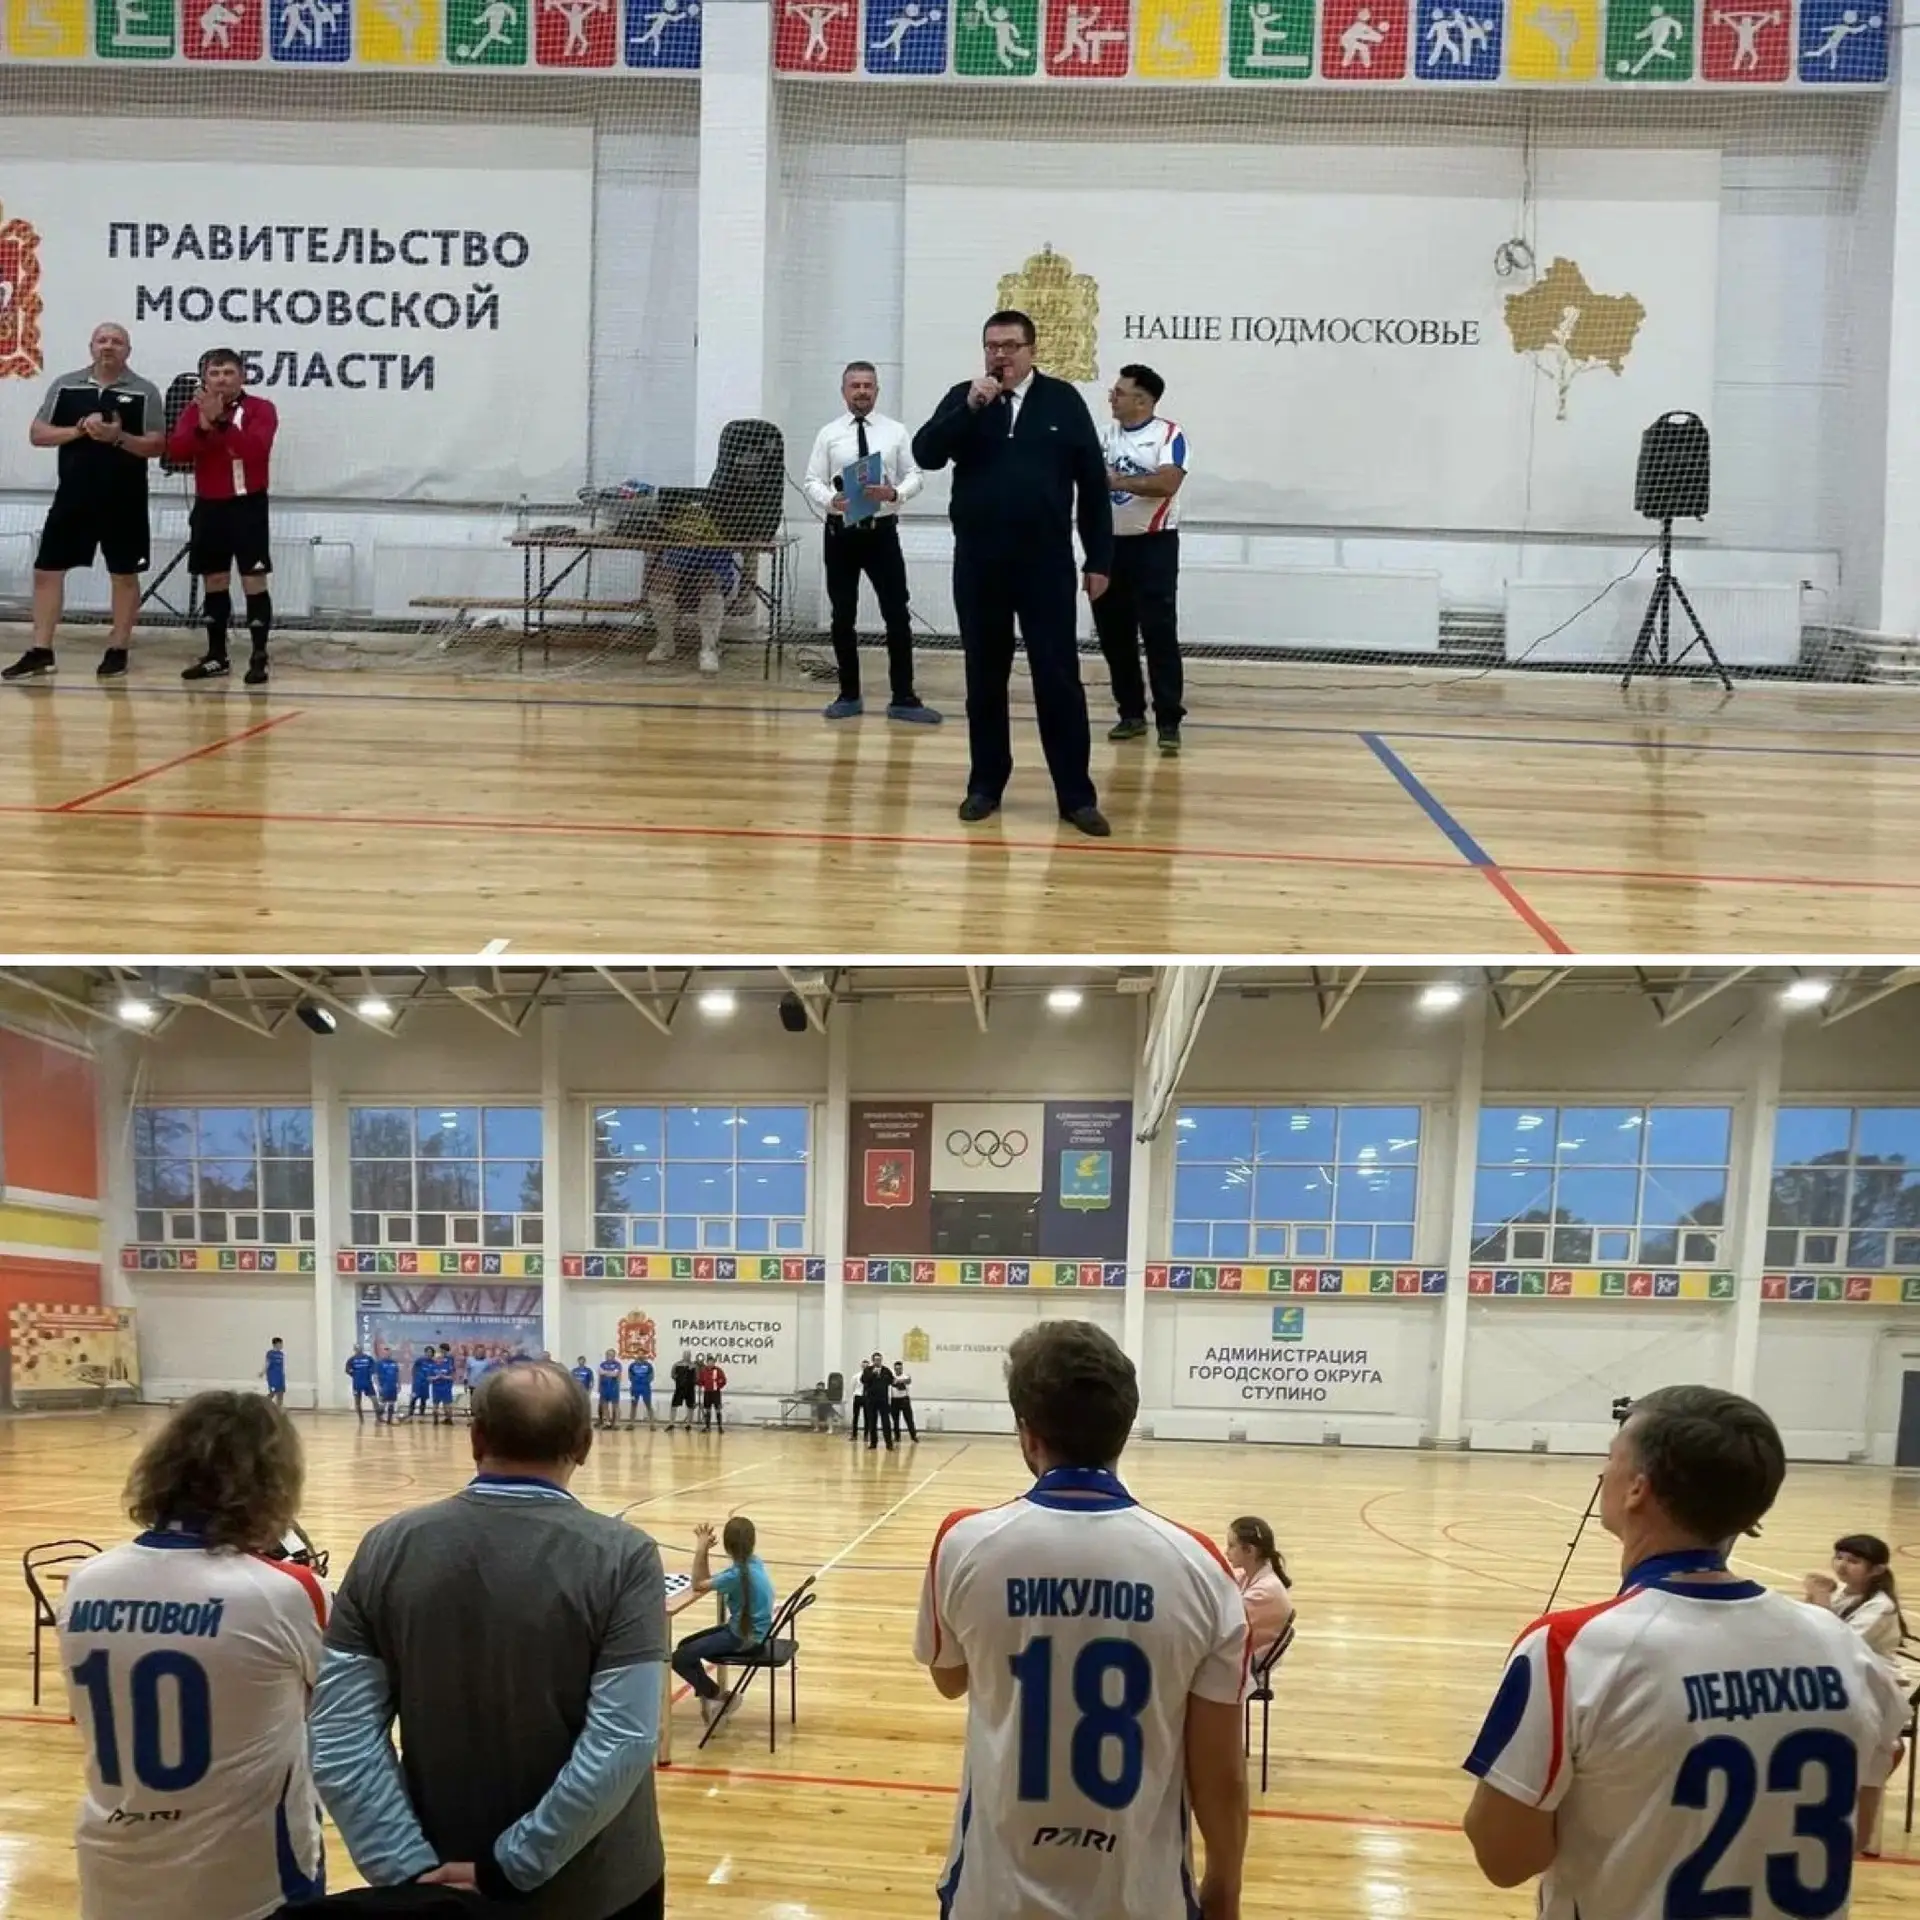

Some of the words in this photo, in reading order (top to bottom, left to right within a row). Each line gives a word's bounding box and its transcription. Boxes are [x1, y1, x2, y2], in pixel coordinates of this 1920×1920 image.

[107, 222, 530, 269] ПРАВИТЕЛЬСТВО
[135, 282, 500, 330] МОСКОВСКОЙ
[1123, 315, 1221, 340] НАШЕ
[1230, 316, 1480, 347] ПОДМОСКОВЬЕ
[239, 349, 436, 391] БЛАСТИ
[671, 1319, 782, 1332] ПРАВИТЕЛЬСТВО
[679, 1336, 774, 1349] МОСКОВСКОЙ
[1189, 1365, 1309, 1382] ГОРОДСКОГО
[1314, 1369, 1383, 1384] ОКРУГА
[1205, 1347, 1368, 1364] АДМИНИСТРАЦИЯ
[1241, 1386, 1328, 1402] СТУПИНО
[67, 1597, 225, 1638] МОСТОВОЙ
[1006, 1577, 1155, 1623] ВИКУЛОВ
[1682, 1665, 1849, 1724] ЛЕДЯХОВ
[70, 1648, 213, 1792] 10
[1008, 1634, 1152, 1811] 18
[1032, 1826, 1117, 1853] PARI
[1662, 1727, 1858, 1920] 23
